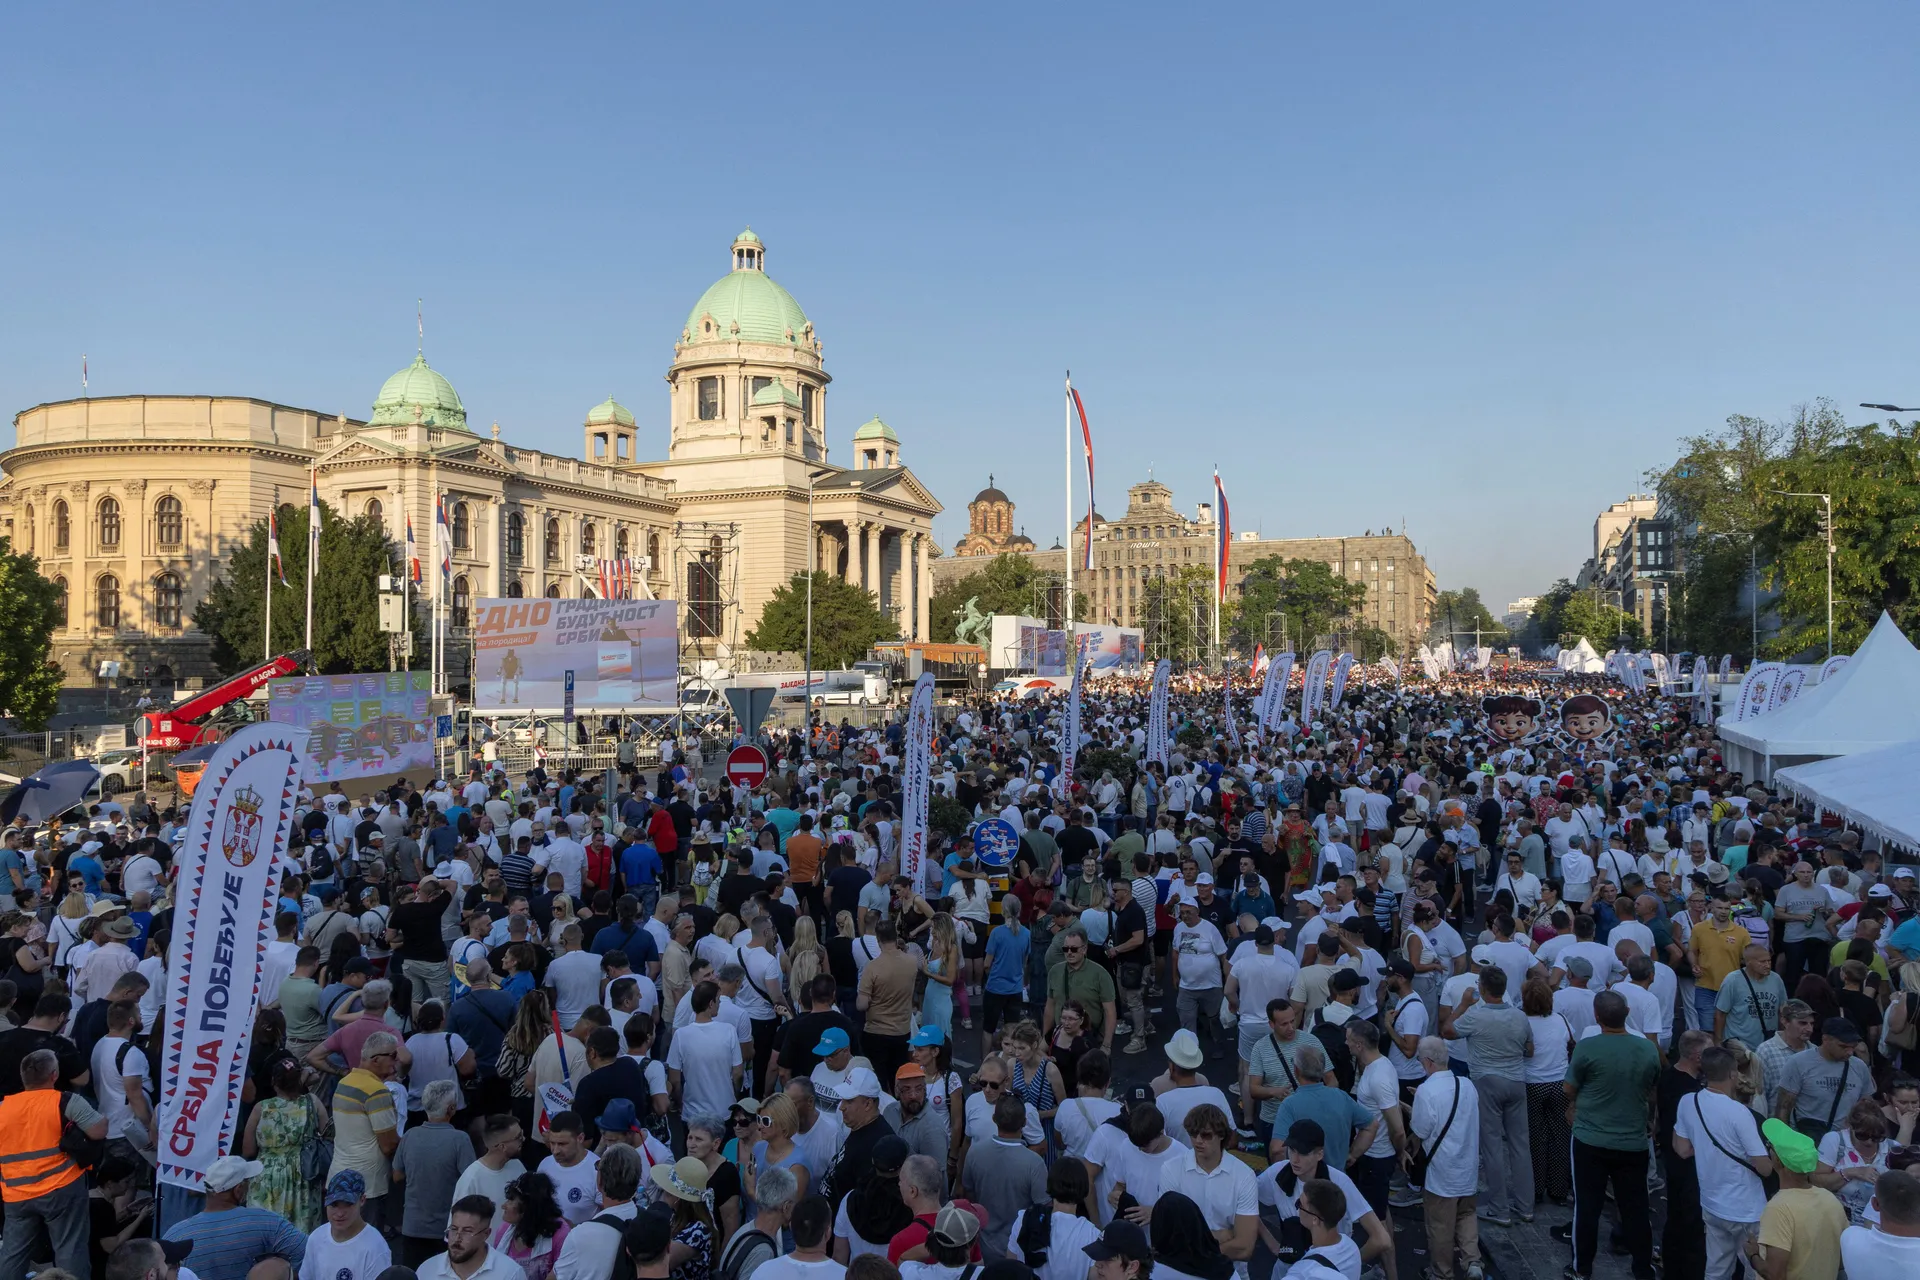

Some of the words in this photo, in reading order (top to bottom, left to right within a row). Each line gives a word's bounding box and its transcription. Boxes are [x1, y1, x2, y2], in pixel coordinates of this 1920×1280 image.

[488, 634, 532, 647] породица!
[556, 628, 602, 645] СРБИ
[250, 667, 277, 685] MAGNI
[780, 679, 806, 689] ЗАЈЕДНО
[168, 1038, 223, 1157] СРБИЈА
[199, 871, 244, 1032] ПОБЕЂУЈЕ
